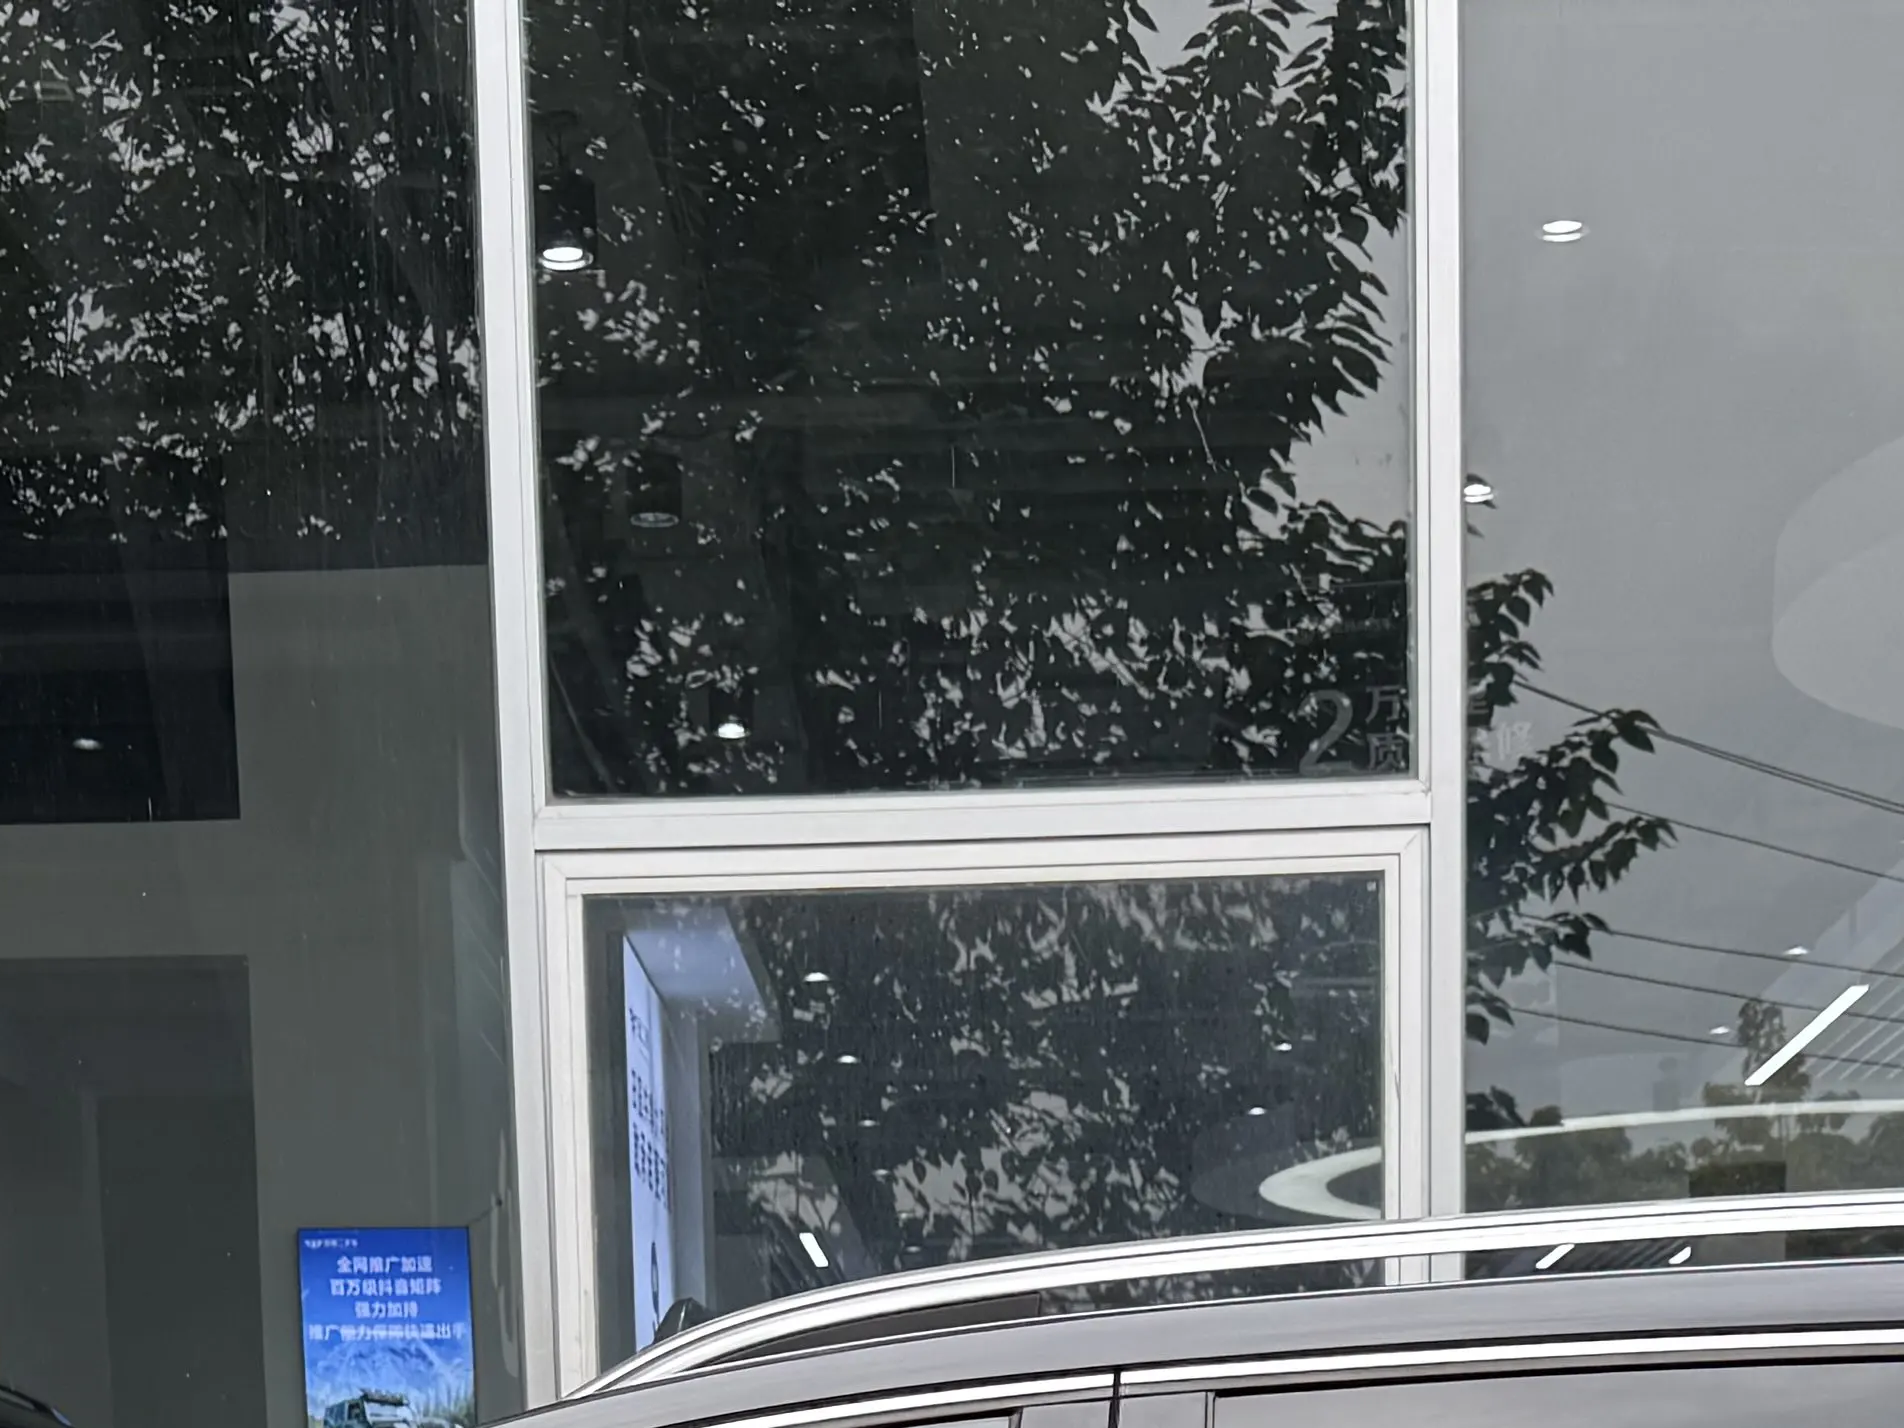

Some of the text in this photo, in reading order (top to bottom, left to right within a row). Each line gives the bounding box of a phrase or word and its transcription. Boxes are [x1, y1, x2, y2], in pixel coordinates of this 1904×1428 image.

[336, 1255, 433, 1274] 全网推广加速
[329, 1277, 442, 1297] 百万级抖音矩阵
[354, 1300, 419, 1319] 强力加持
